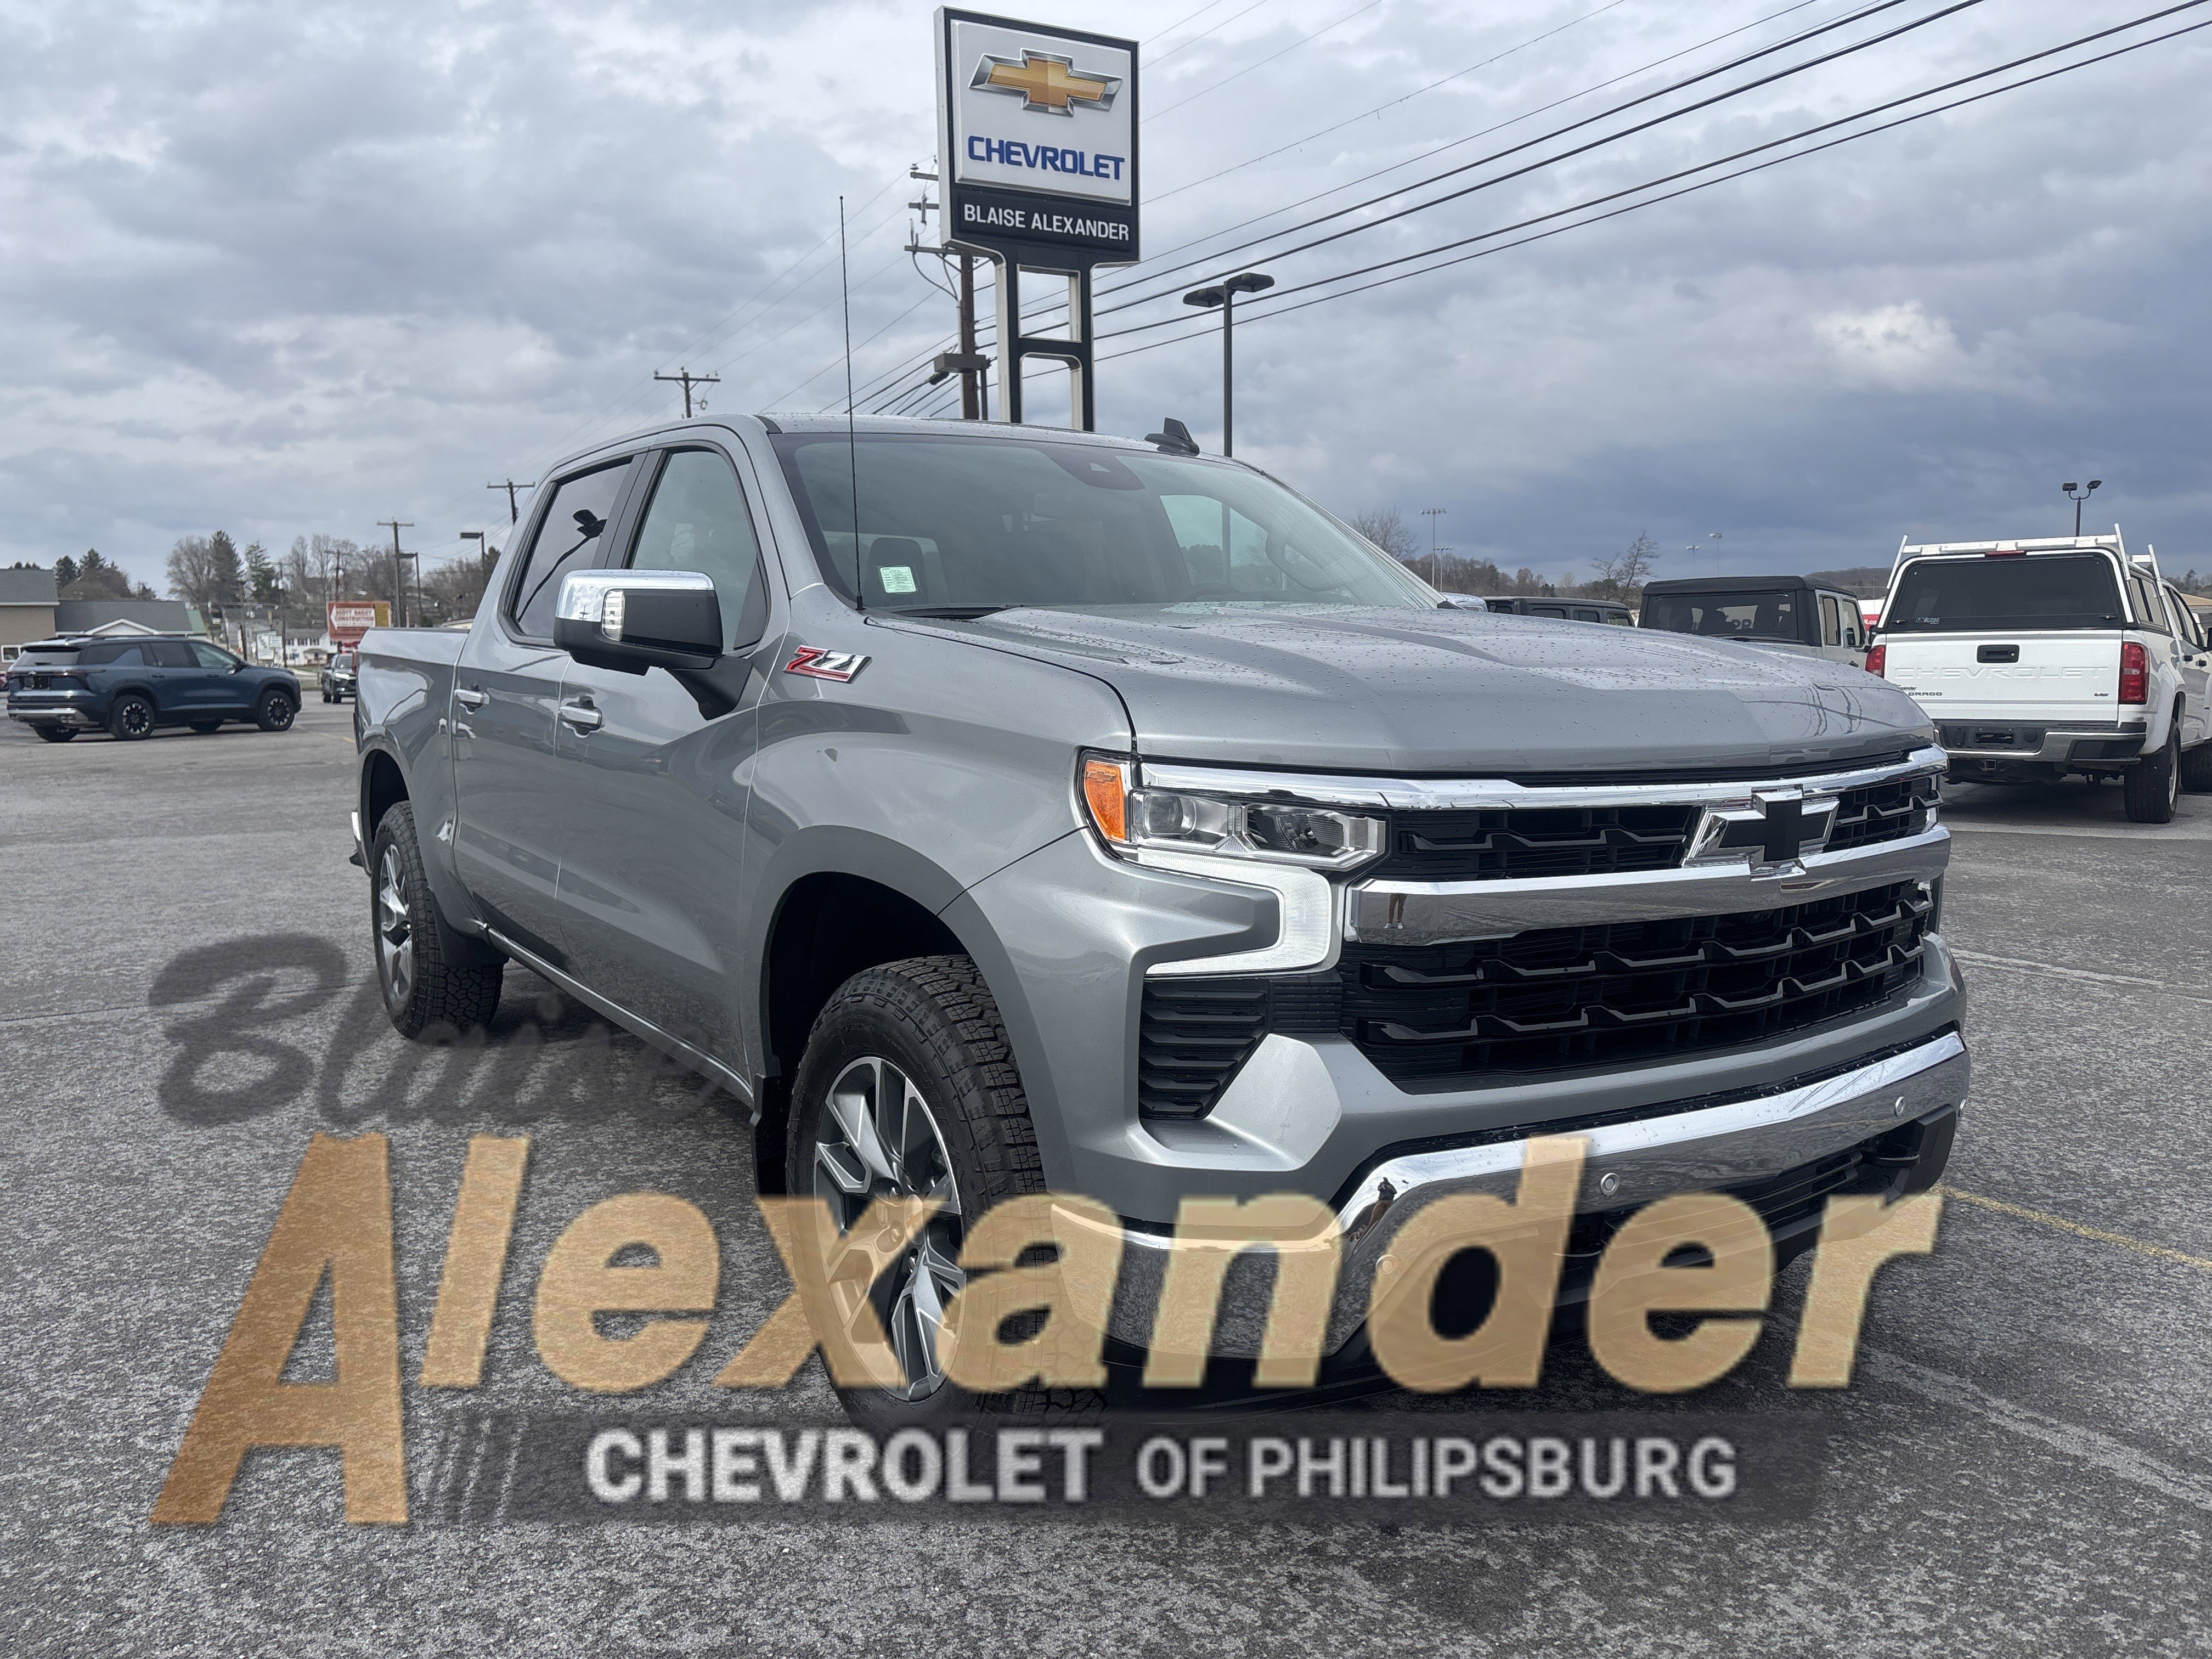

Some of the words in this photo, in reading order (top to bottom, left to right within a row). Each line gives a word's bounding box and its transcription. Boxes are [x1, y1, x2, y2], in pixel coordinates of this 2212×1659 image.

[968, 135, 1125, 180] CHEVROLET
[963, 204, 1026, 228] BLAISE
[1030, 212, 1130, 241] ALEXANDER
[783, 645, 873, 684] Z71
[1894, 667, 2108, 679] CHEVROLET
